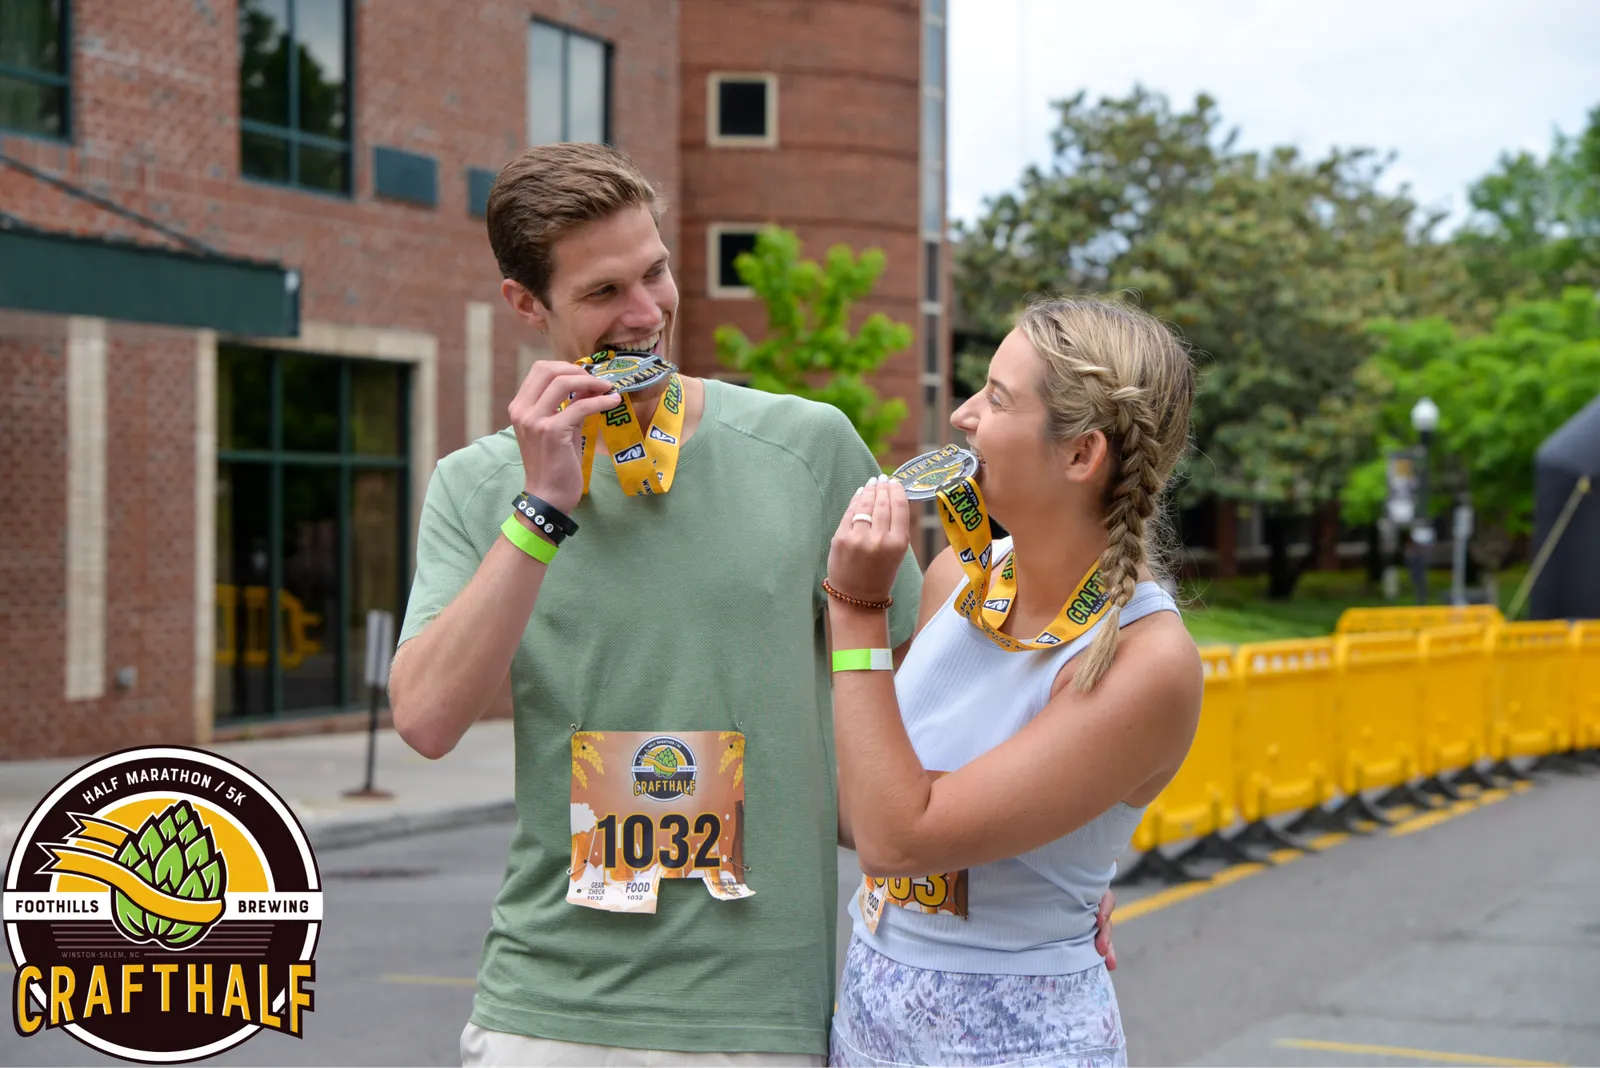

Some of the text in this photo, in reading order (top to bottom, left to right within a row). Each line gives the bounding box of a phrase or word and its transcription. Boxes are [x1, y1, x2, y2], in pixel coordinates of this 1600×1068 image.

[611, 361, 676, 393] RAFTHALF
[633, 780, 696, 797] CRAFTHALF
[597, 812, 722, 870] 1032
[590, 881, 605, 889] GEAR
[625, 882, 650, 893] FOOD
